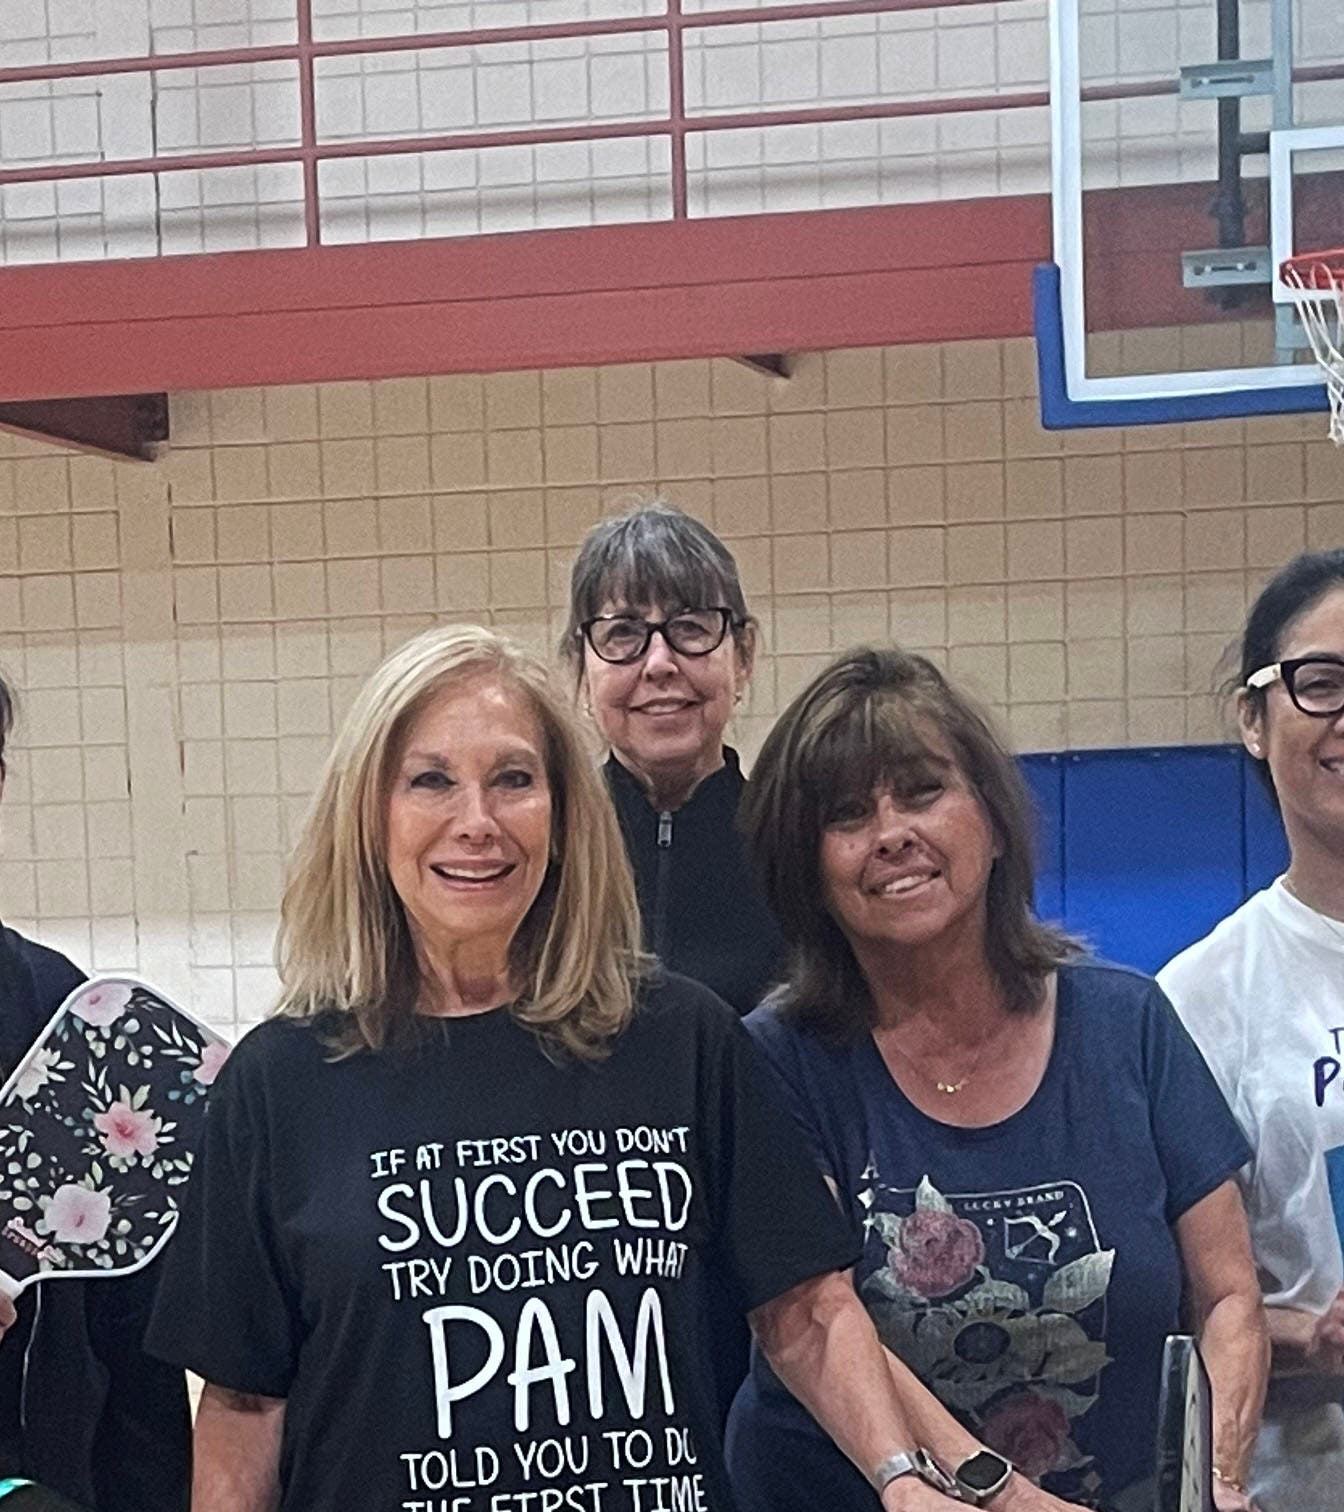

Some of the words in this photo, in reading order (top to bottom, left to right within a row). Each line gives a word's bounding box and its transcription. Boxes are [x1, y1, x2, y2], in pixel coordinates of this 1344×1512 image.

[370, 1149, 406, 1178] IF
[416, 1143, 444, 1171] AT
[456, 1135, 542, 1167] FIRST
[551, 1129, 606, 1157] YOU
[615, 1125, 689, 1154] DON'T
[377, 1159, 692, 1252] SUCCEED
[382, 1257, 452, 1300] TRY
[468, 1241, 599, 1293] DOING
[614, 1238, 688, 1279] WHAT
[422, 1287, 674, 1439] PAM
[400, 1447, 499, 1490] TOLD
[513, 1436, 588, 1481] YOU
[603, 1429, 653, 1469] TO
